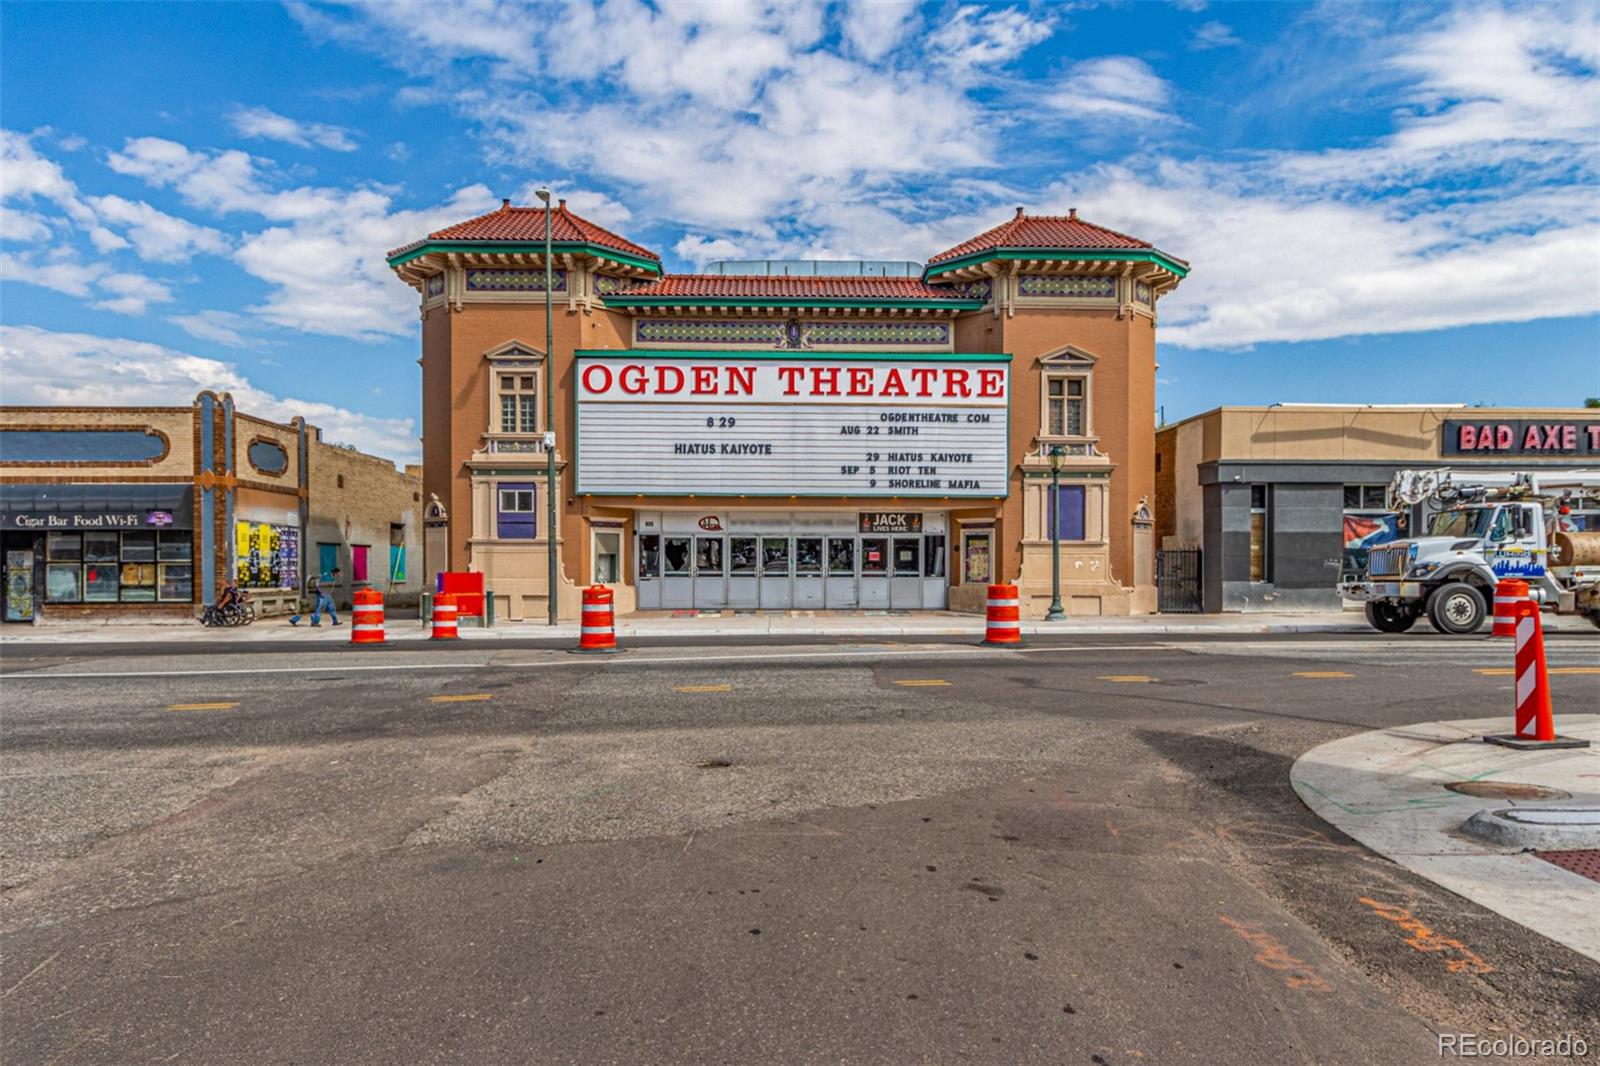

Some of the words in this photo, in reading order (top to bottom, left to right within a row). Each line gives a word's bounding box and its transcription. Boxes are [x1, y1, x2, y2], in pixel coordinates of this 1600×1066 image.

[581, 364, 757, 396] OGDEN
[777, 366, 1005, 399] THEATRE
[706, 416, 714, 428] 8
[718, 416, 736, 428] 29
[880, 412, 959, 423] OGDENTHEATRE
[966, 413, 990, 424] COM
[839, 425, 861, 435] AUG
[866, 425, 880, 435] 22
[887, 426, 919, 436] SMITH
[1459, 425, 1513, 450] BAD
[1522, 425, 1577, 450] AXE
[674, 443, 716, 455] HIATUS
[720, 443, 773, 455] KAIYOTE
[866, 452, 880, 462] 29
[887, 452, 923, 462] HIATUS
[930, 453, 974, 463] KAIYOTE
[840, 465, 860, 475] SEP
[869, 465, 876, 475] 5
[887, 465, 912, 475] RIOT
[917, 466, 937, 476] TEN
[869, 479, 877, 489] 9
[888, 479, 942, 489] SHORELINE
[948, 480, 981, 490] MAFIA
[15, 514, 46, 528] Cigar
[48, 515, 69, 526] Bar
[73, 514, 104, 526] Food
[105, 514, 139, 526] Wi-Fi
[872, 513, 907, 526] JACK
